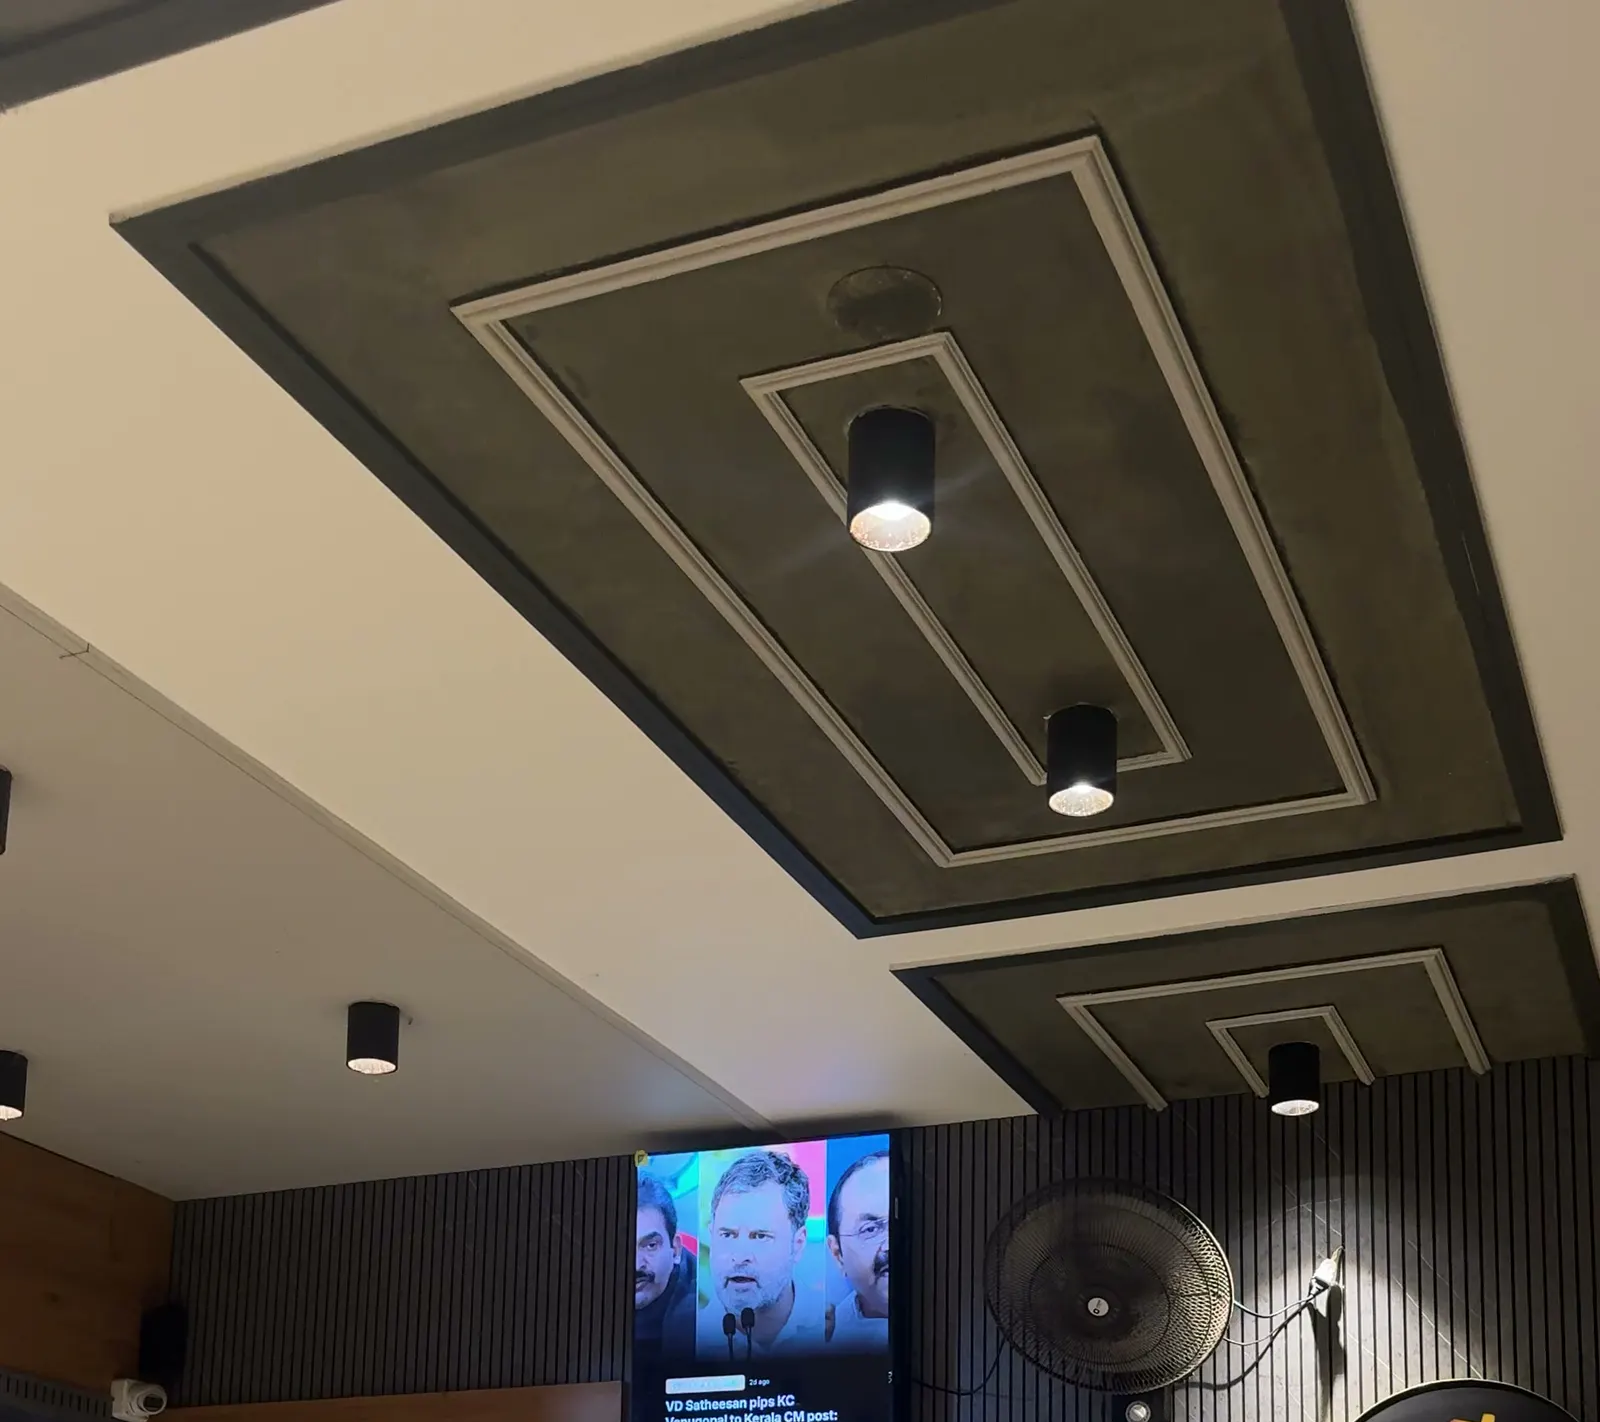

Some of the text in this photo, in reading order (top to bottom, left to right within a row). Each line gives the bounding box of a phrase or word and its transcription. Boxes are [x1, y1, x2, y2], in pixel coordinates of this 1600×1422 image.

[665, 1395, 795, 1412] VD Satheesan pips KC
[784, 1411, 804, 1422] CM
